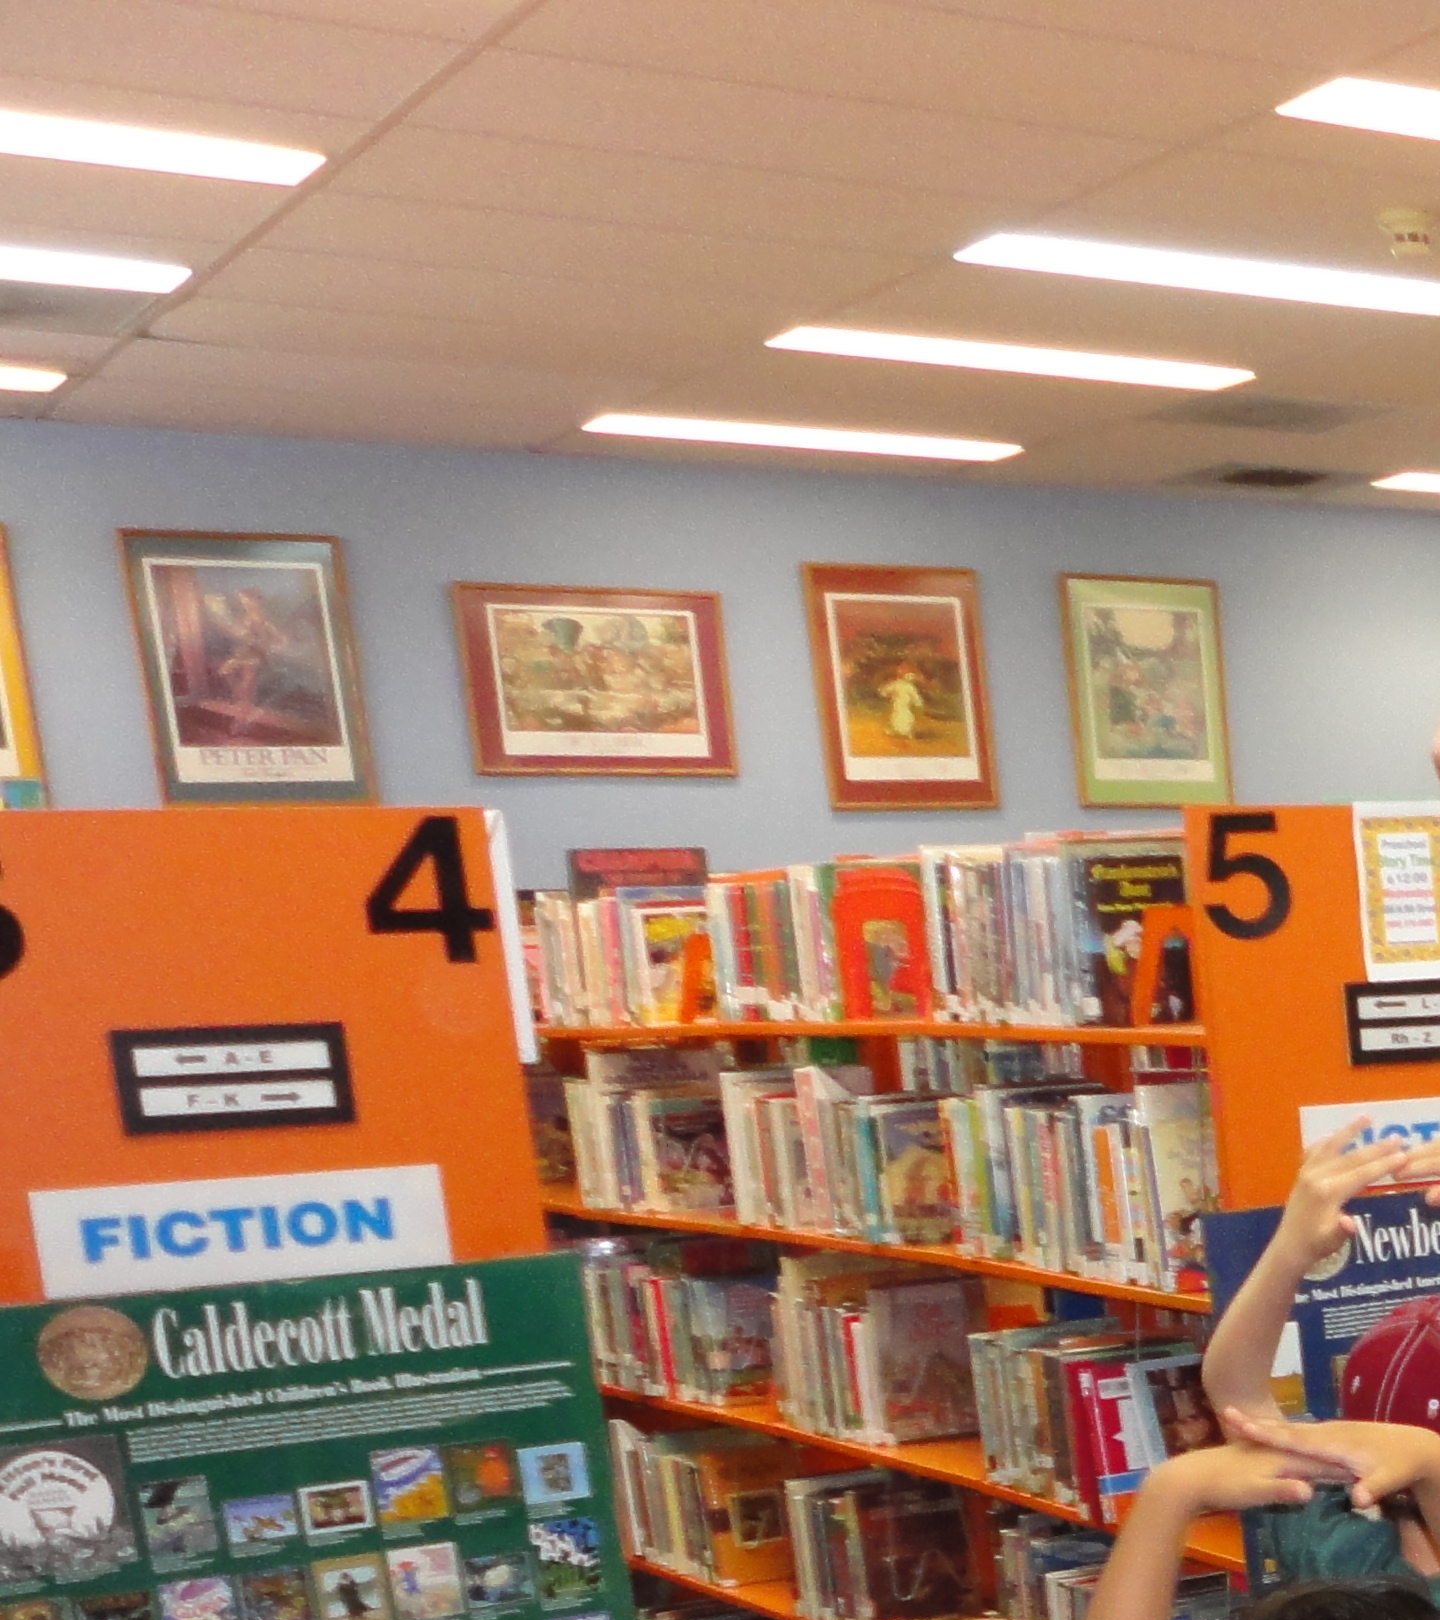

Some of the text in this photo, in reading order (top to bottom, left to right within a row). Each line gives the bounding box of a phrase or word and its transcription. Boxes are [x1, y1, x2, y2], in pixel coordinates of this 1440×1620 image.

[200, 748, 328, 766] PETER PAN
[364, 815, 496, 964] 4
[1204, 811, 1292, 940] 5
[1421, 999, 1429, 1009] L
[224, 1051, 239, 1065] A
[259, 1050, 274, 1064] E
[187, 1093, 199, 1107] F
[224, 1093, 239, 1107] K
[79, 1198, 396, 1265] FICTION
[1311, 1288, 1339, 1301] Most
[1340, 1277, 1412, 1298] Distinguished
[153, 1277, 489, 1380] Caldecott Medal
[63, 1410, 99, 1428] The
[102, 1405, 145, 1422] Most
[148, 1389, 264, 1417] Distinguished
[265, 1381, 348, 1404] Children's
[350, 1375, 394, 1393] Book
